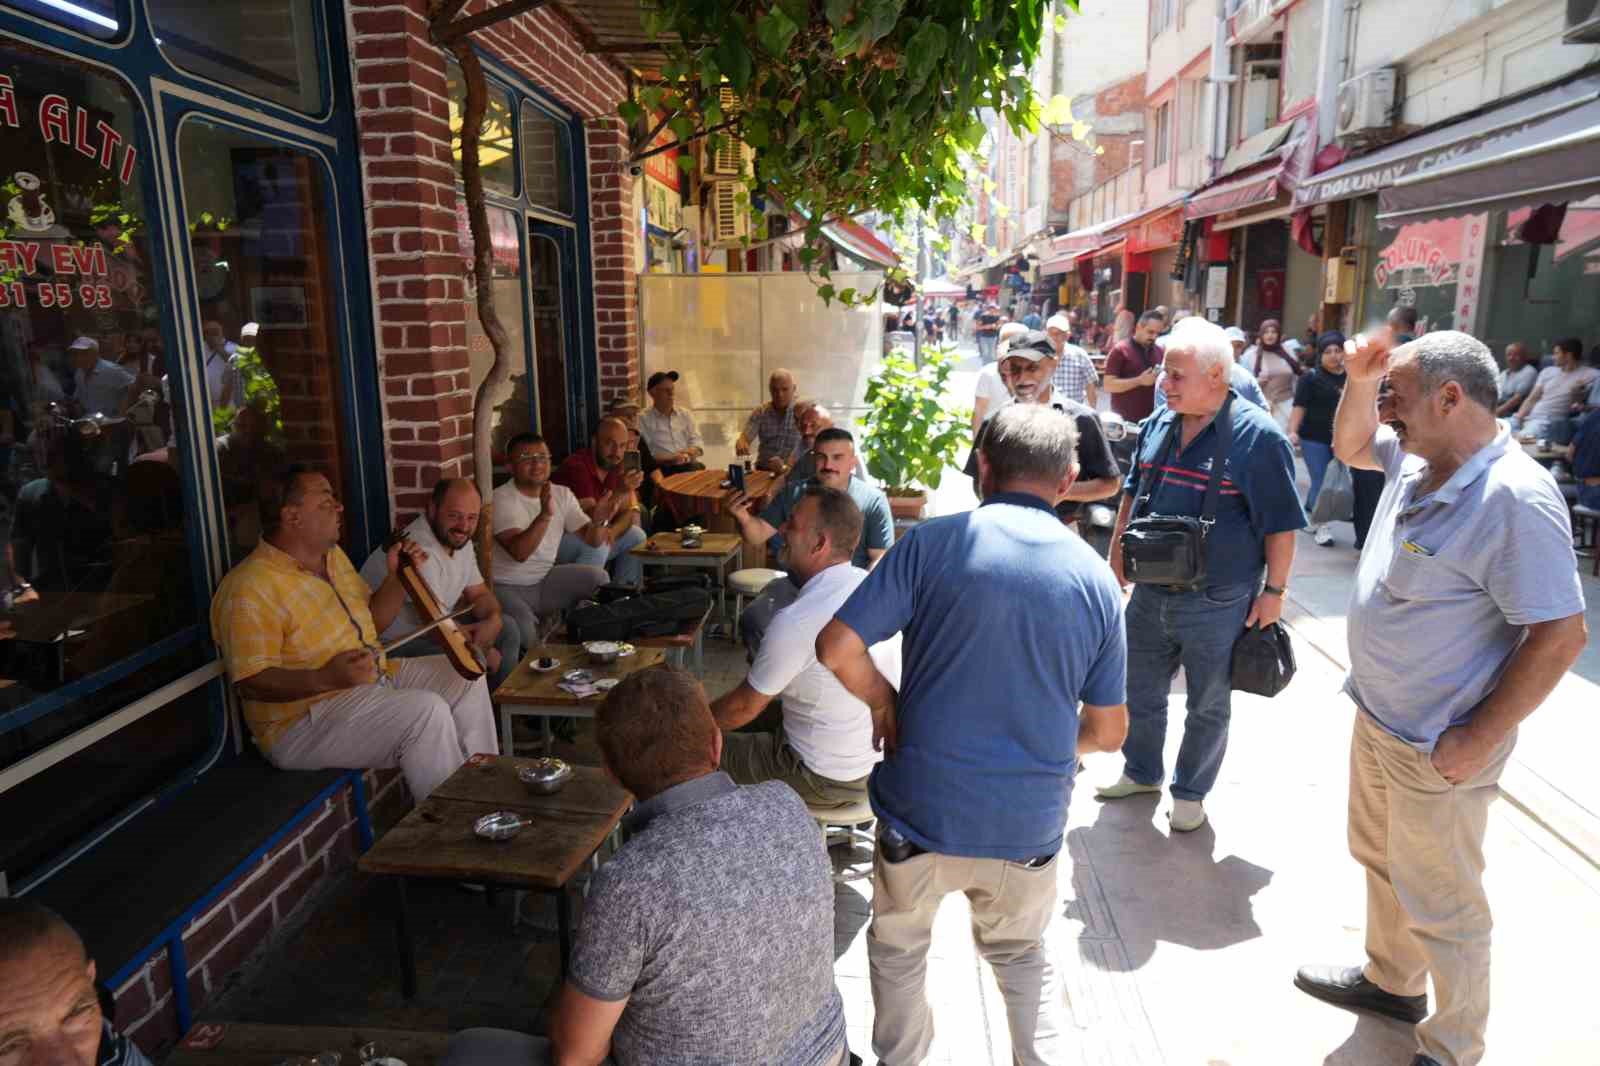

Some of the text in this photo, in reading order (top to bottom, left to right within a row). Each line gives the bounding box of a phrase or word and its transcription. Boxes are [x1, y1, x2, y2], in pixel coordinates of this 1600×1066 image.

[39, 94, 137, 184] ALTI
[1320, 164, 1406, 199] DOLUNAY
[51, 241, 108, 276] EVİ
[1374, 237, 1452, 288] DOLUNAY
[38, 282, 73, 308] 55
[79, 284, 113, 308] 93
